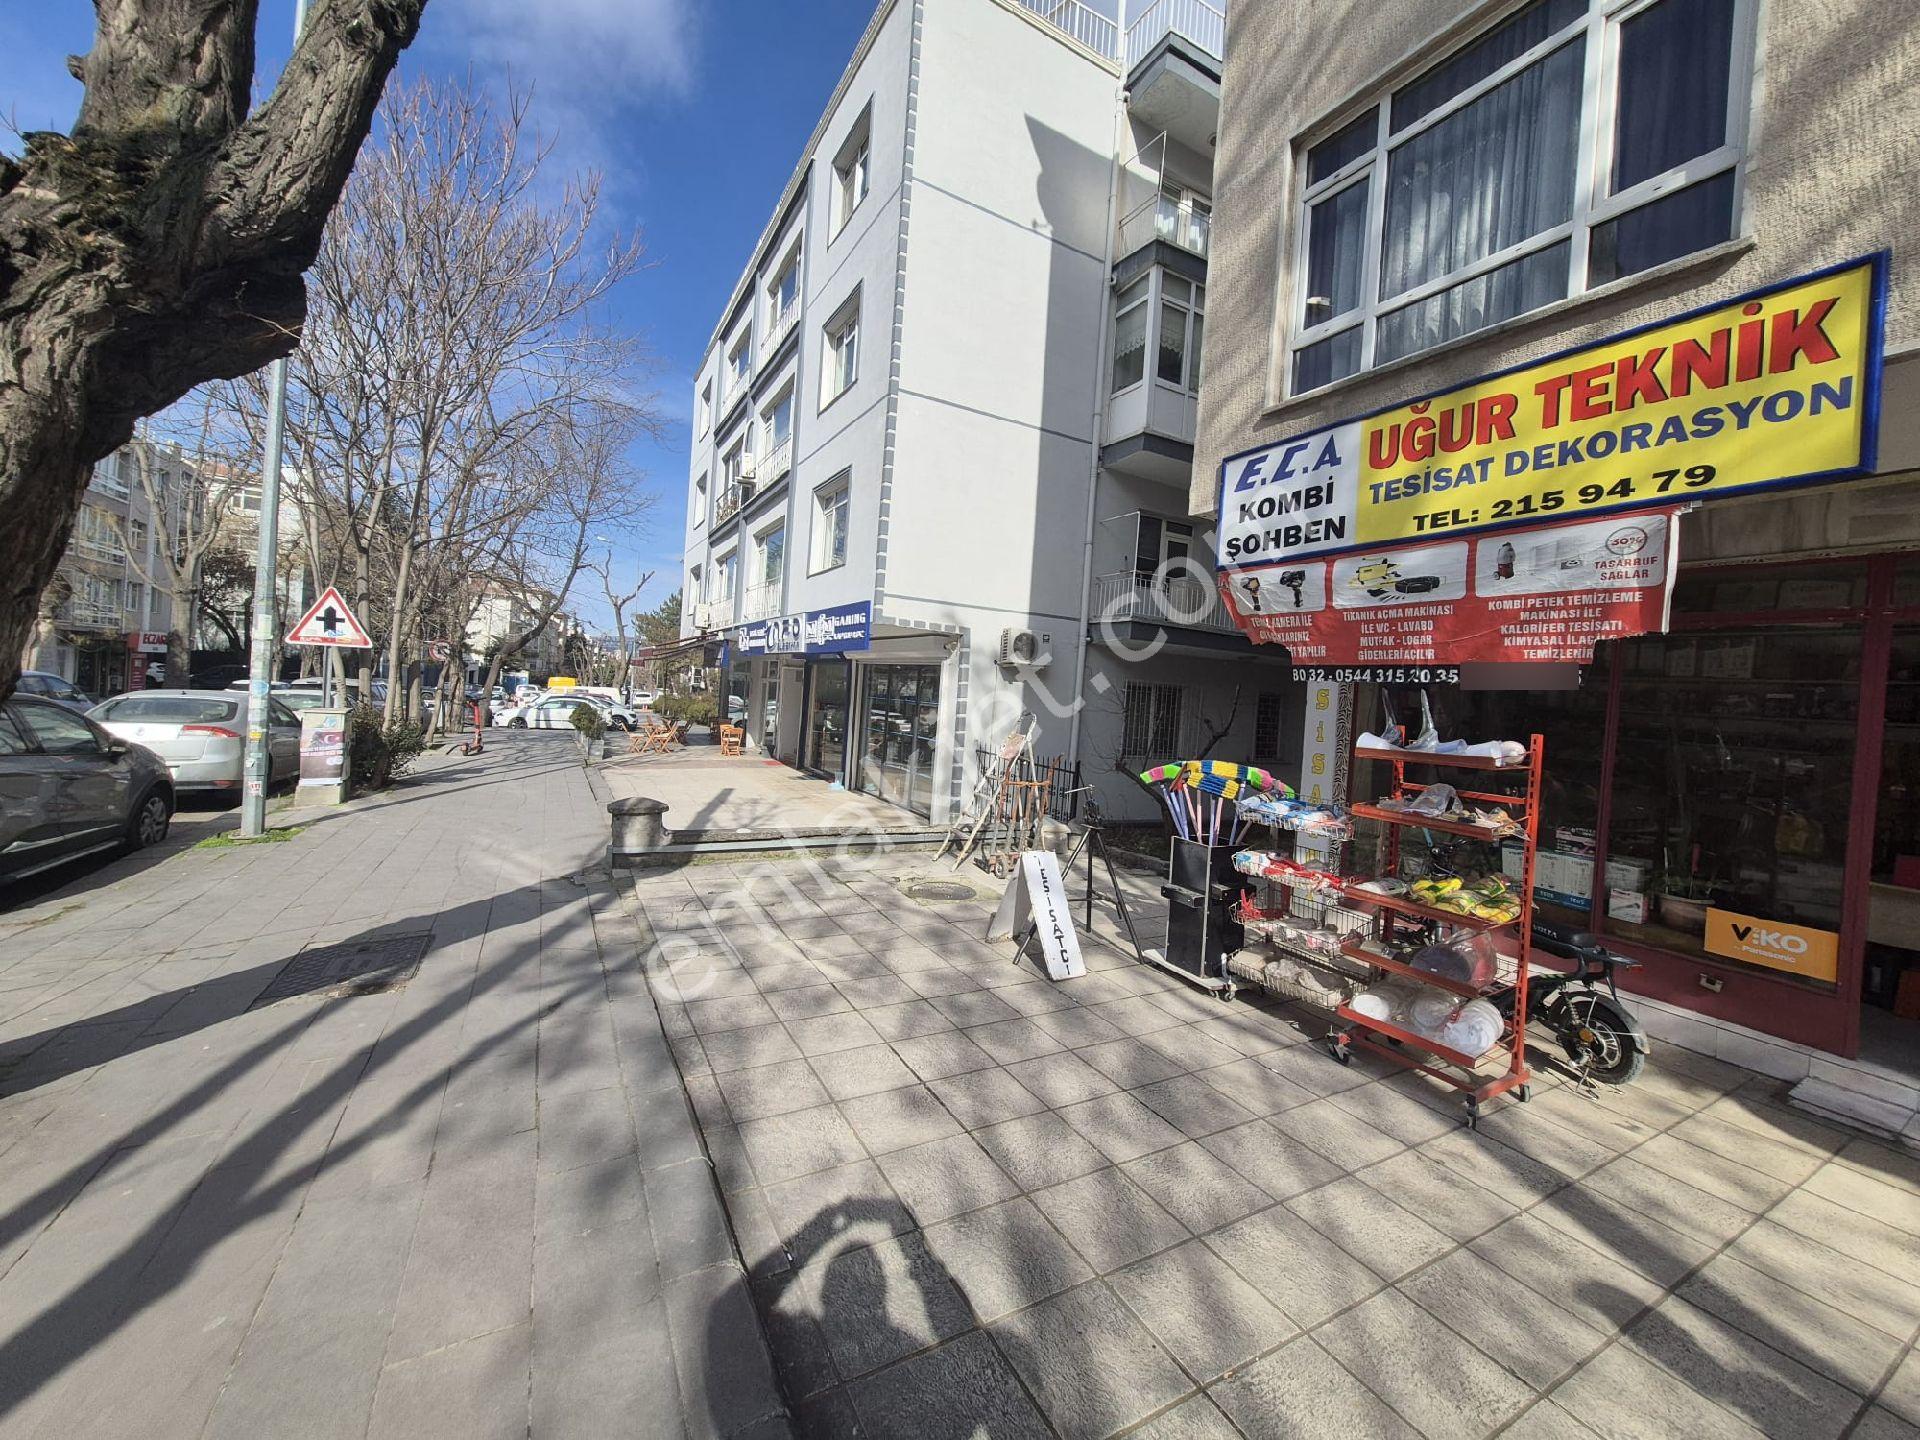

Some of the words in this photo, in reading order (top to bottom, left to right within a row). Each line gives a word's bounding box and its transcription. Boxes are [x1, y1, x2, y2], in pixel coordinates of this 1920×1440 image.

[1368, 393, 1518, 470] UĞUR
[1535, 297, 1841, 430] TEKNİK
[1369, 456, 1495, 504] TESİSAT
[1505, 375, 1853, 477] DEKORASYON
[1238, 476, 1334, 524] KOMBİ
[1413, 508, 1479, 531] TEL:
[1491, 490, 1564, 519] 215
[1578, 477, 1636, 504] 94
[1652, 464, 1717, 492] 79
[1226, 515, 1346, 563] ŞOHBEN
[1595, 556, 1659, 569] TASARRUF
[1488, 596, 1525, 611] KOMBİ
[1527, 596, 1564, 608] PETEK
[1567, 591, 1643, 606] TEMİZLEME
[1584, 606, 1602, 617] İLE
[1361, 622, 1375, 634] İLE
[1376, 622, 1390, 633] WC
[1398, 620, 1434, 632] LAVABO
[1500, 621, 1565, 635] KALORİFER
[1568, 619, 1623, 632] TESİSATI
[1360, 635, 1395, 647] MUTFAK
[1504, 634, 1564, 647] KİMYASAL
[1335, 668, 1371, 682] 0544
[1376, 668, 1405, 683] 315
[1435, 668, 1460, 683] 35
